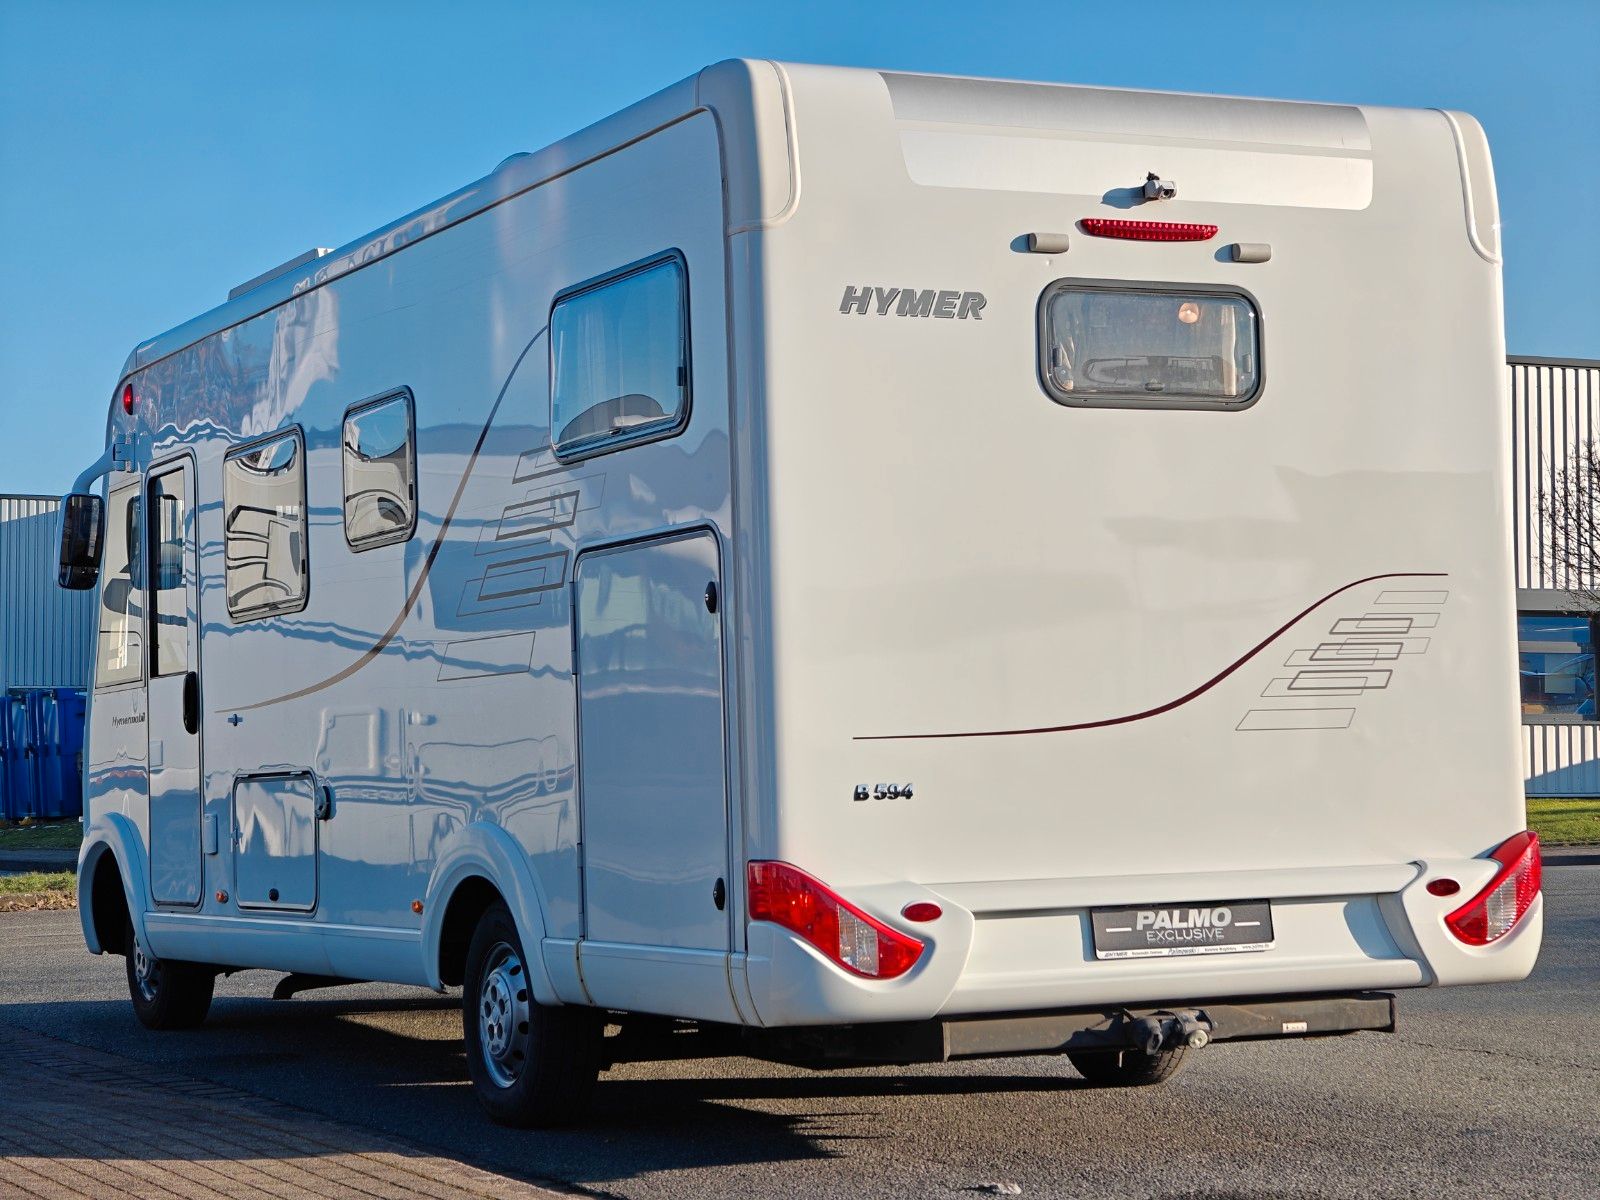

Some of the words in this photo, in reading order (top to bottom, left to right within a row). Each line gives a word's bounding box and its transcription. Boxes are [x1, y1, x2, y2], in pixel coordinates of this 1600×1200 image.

[839, 286, 987, 320] HYMER
[853, 784, 869, 801] B
[873, 783, 913, 800] 594
[1136, 908, 1232, 930] PALMO
[1146, 928, 1225, 941] EXCLUSIVE
